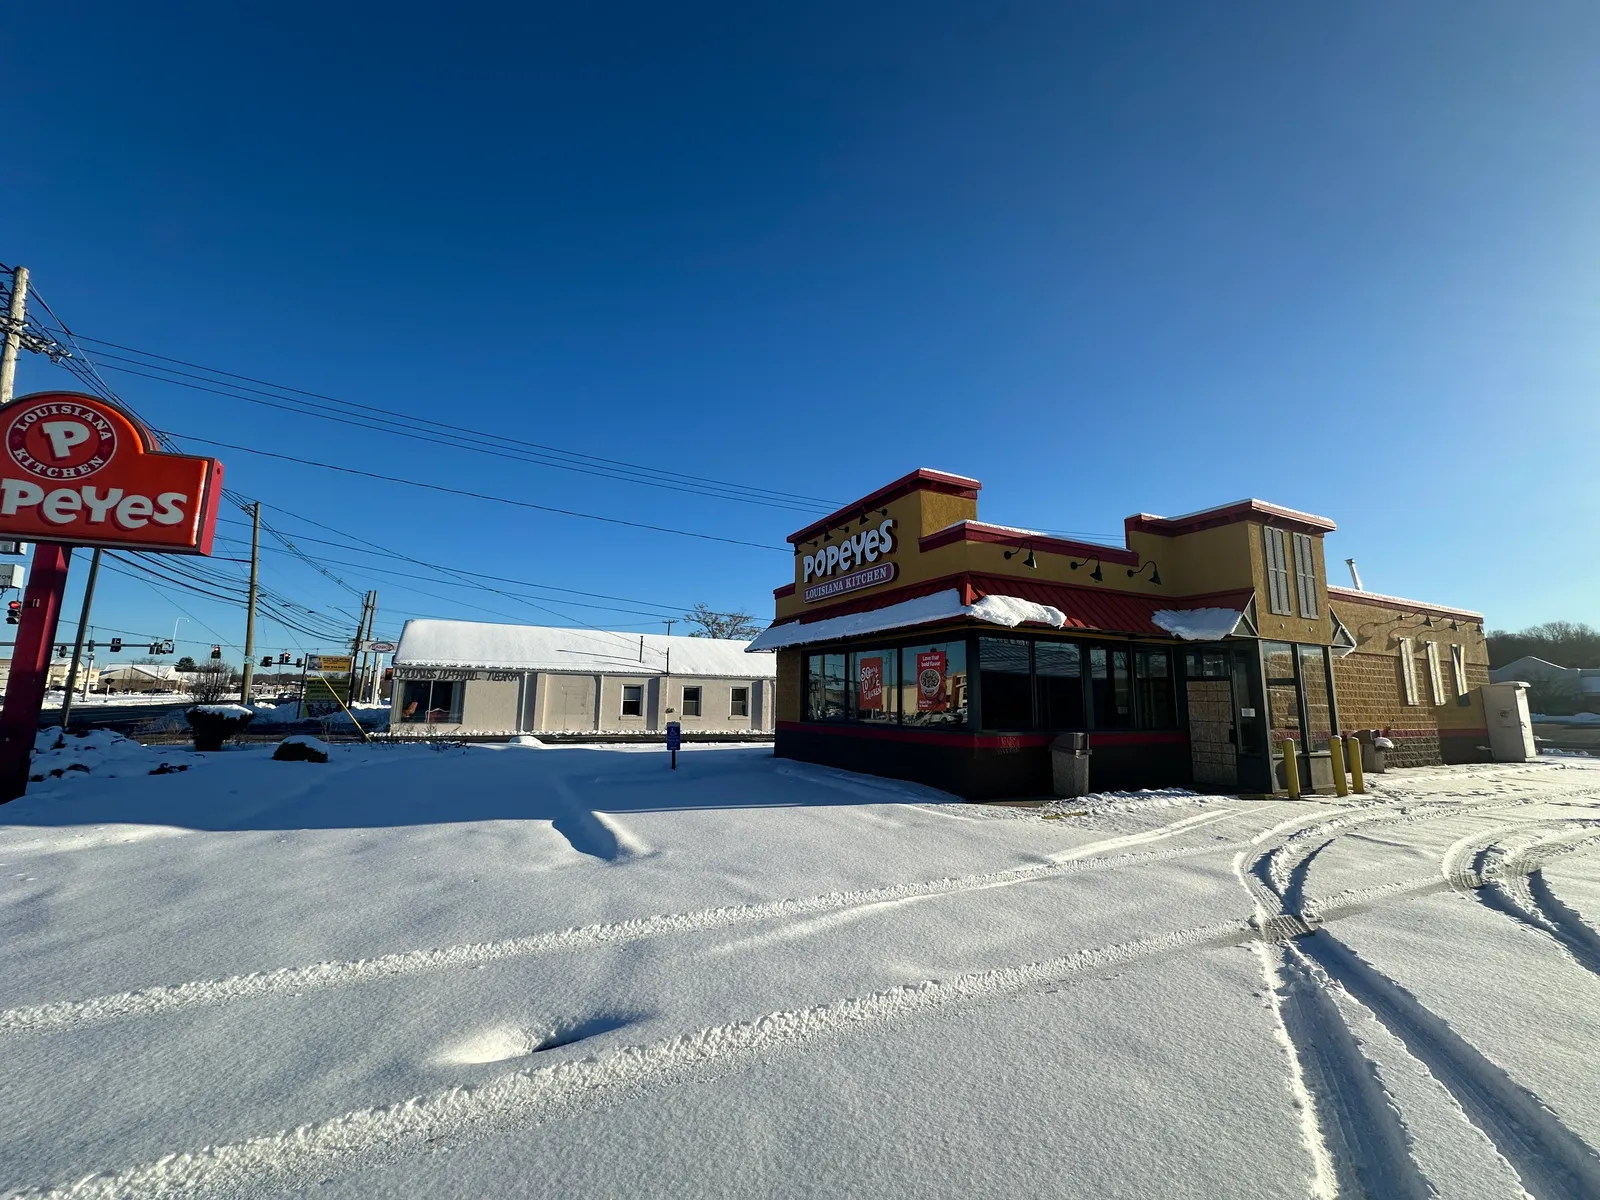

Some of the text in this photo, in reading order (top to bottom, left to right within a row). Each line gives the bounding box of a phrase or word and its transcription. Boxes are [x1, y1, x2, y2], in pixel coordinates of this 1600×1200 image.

[14, 405, 112, 441] LOUISIANA
[41, 420, 91, 458] P
[13, 447, 104, 478] KITCHEN
[805, 566, 887, 600] LOUISIANA KITCHEN
